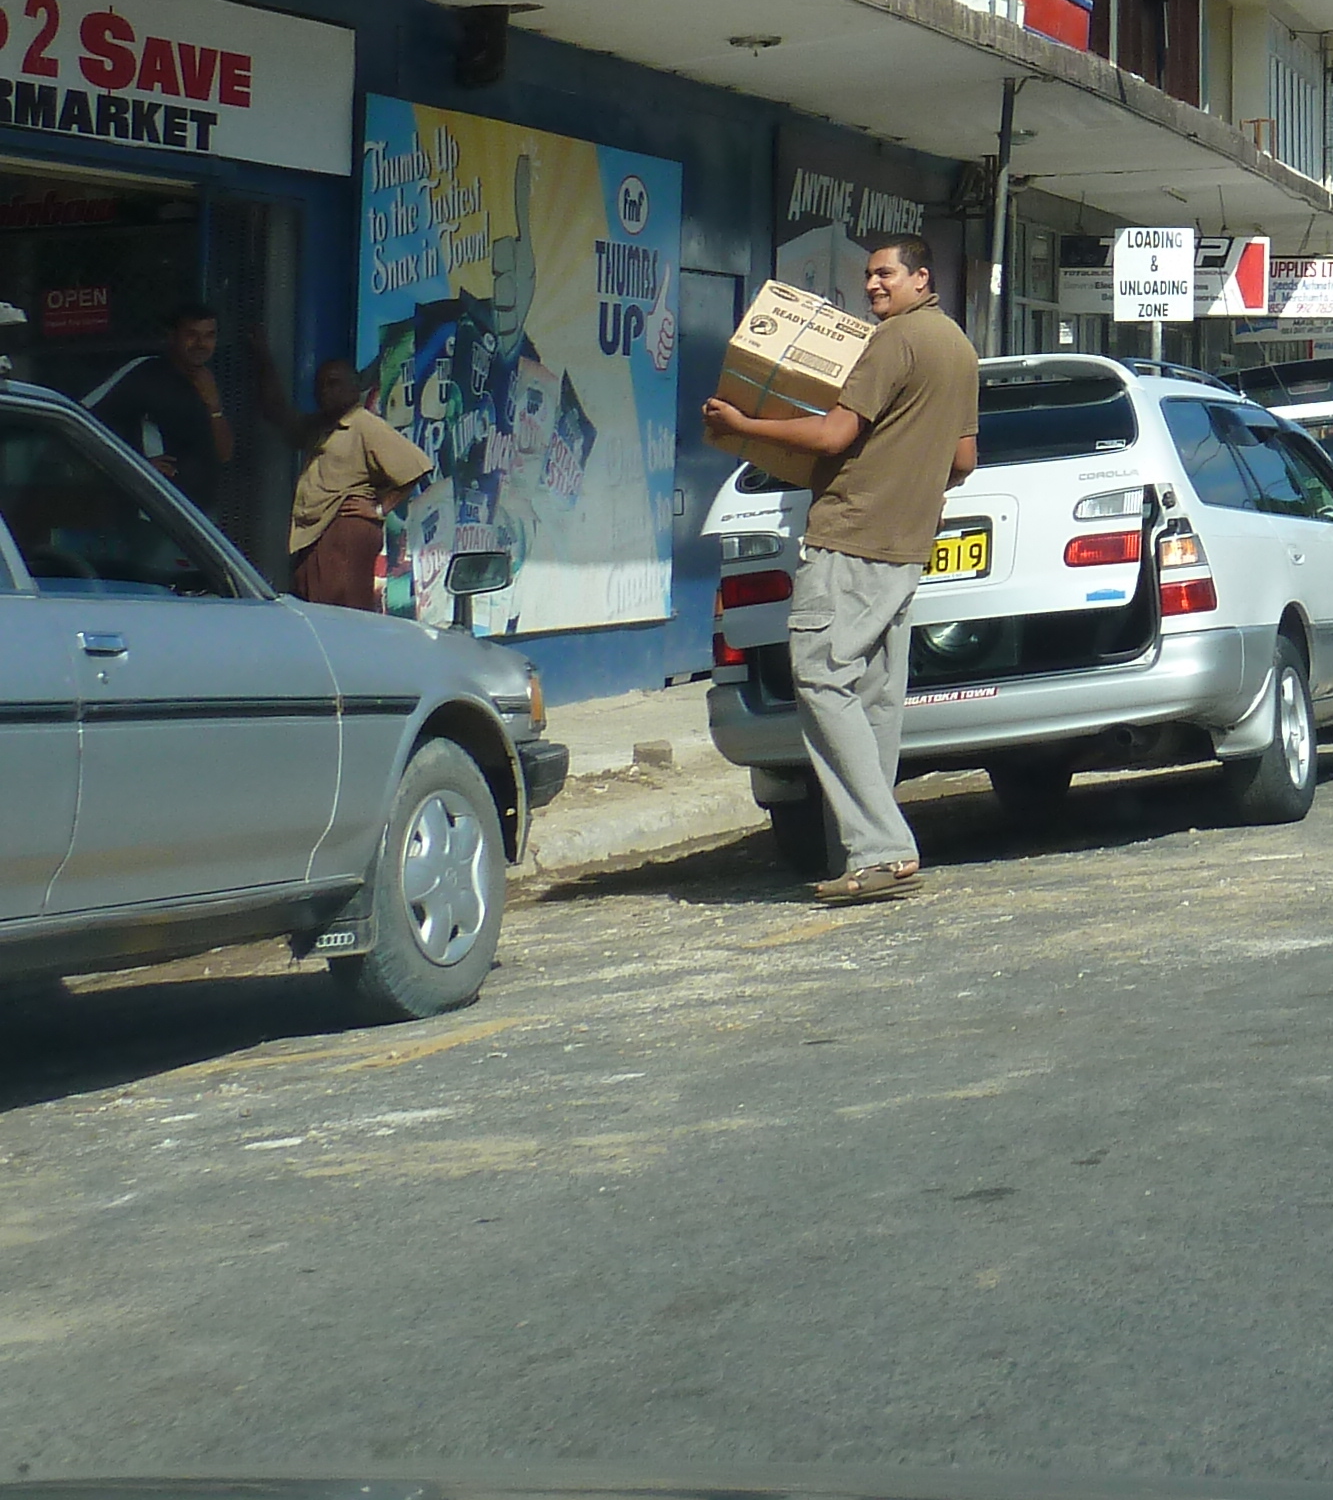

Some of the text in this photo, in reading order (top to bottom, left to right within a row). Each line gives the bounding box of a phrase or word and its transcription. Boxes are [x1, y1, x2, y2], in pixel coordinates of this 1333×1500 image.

[364, 124, 460, 193] Thumbs Up
[368, 175, 483, 244] to the Tastiest
[788, 168, 925, 238] ANYTIME, ANYWHERE
[1127, 230, 1183, 249] LOADING
[372, 244, 420, 295] Snax
[422, 238, 439, 279] in
[595, 240, 658, 301] THUMBS
[1150, 255, 1158, 273] &
[1269, 261, 1317, 279] UPPLIES
[47, 288, 107, 308] OPEN
[1119, 280, 1188, 296] UNLOADING
[1138, 303, 1169, 318] ZONE
[600, 301, 645, 357] UP
[772, 306, 808, 326] READY
[807, 321, 845, 342] SALTED
[1078, 470, 1140, 481] COROLLA
[960, 686, 996, 699] TOWN
